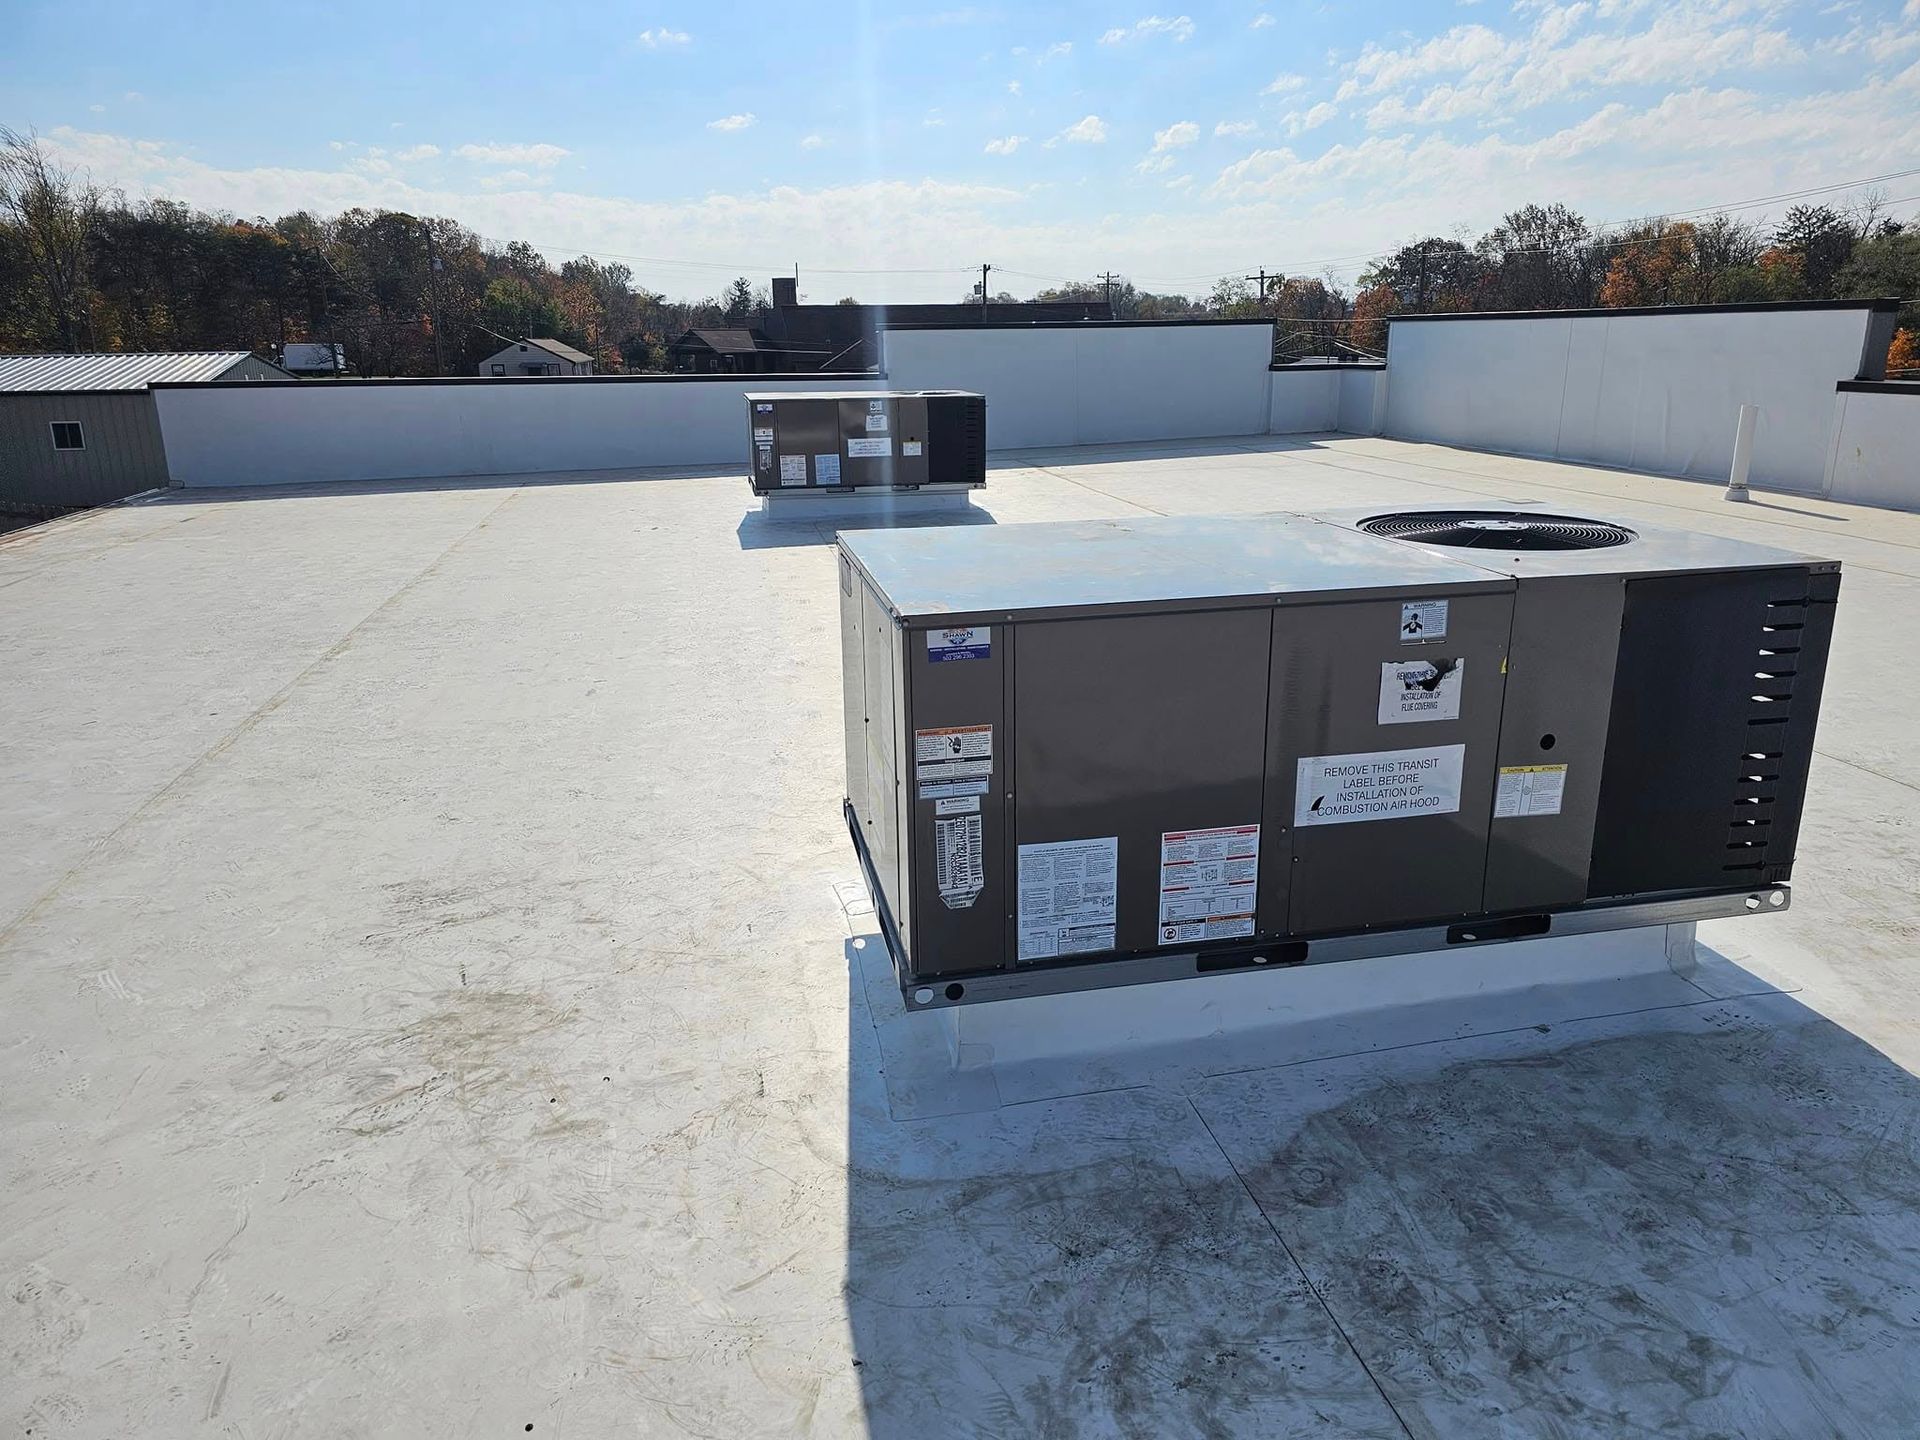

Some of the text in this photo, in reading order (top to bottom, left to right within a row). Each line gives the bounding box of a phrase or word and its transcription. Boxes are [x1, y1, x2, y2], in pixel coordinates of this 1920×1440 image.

[942, 630, 974, 639] SHAWN
[1400, 690, 1442, 701] INSTALLATION OF
[1401, 701, 1438, 712] FLUE COVERING
[1324, 758, 1439, 777] REMOVE THIS TRANSIT
[1343, 773, 1419, 789] LABEL BEFORE
[1336, 785, 1424, 802] INSTALLATION OF
[1316, 796, 1440, 817] COMBUSTION AIR HOOD
